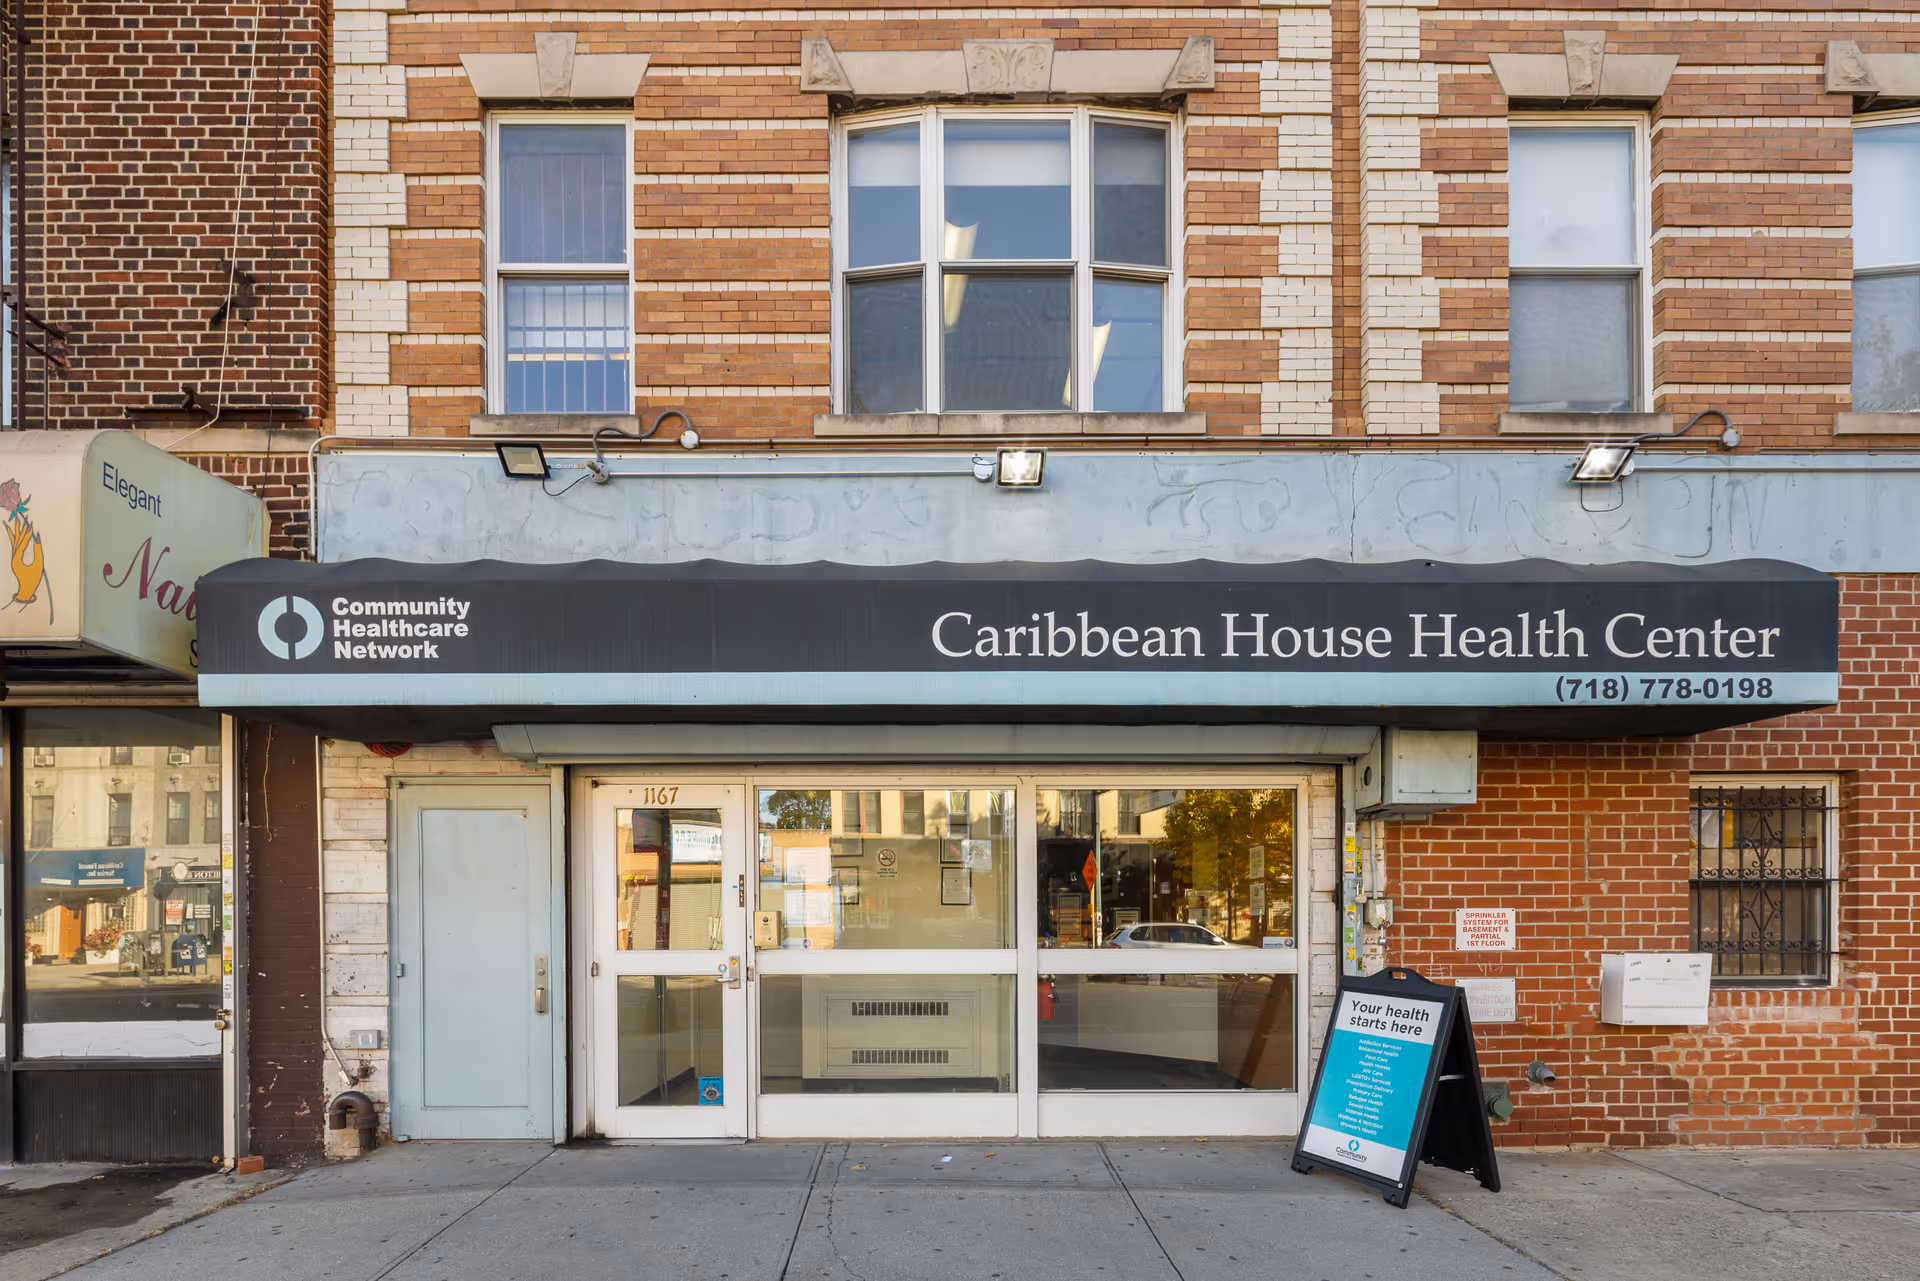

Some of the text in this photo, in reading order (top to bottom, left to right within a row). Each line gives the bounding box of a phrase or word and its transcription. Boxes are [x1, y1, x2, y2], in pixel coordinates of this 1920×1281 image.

[103, 461, 162, 518] Elegant
[332, 597, 470, 620] Community
[333, 619, 469, 637] Healthcare
[932, 608, 1781, 658] Caribbean House Health Center
[334, 640, 439, 659] Network
[1556, 675, 1773, 702] (718) 778-0198
[644, 787, 679, 805] 1167
[1352, 1000, 1430, 1022] Your health
[1350, 1016, 1422, 1036] starts here
[1358, 1045, 1383, 1054] Behavioral
[1359, 1039, 1402, 1050] Addiction Services
[1374, 1063, 1391, 1071] Homes
[1345, 1078, 1393, 1094] Prescription Delivery
[1371, 1077, 1391, 1085] Services
[1348, 1094, 1367, 1103] Refugee
[1352, 1087, 1370, 1096] Primary
[1345, 1107, 1379, 1120] Veteran Health
[1348, 1101, 1379, 1113] Sexual Health
[1337, 1112, 1358, 1122] Wellness
[1362, 1119, 1384, 1129] Nutrition
[1361, 1127, 1377, 1136] Health
[1335, 1146, 1368, 1162] Community
